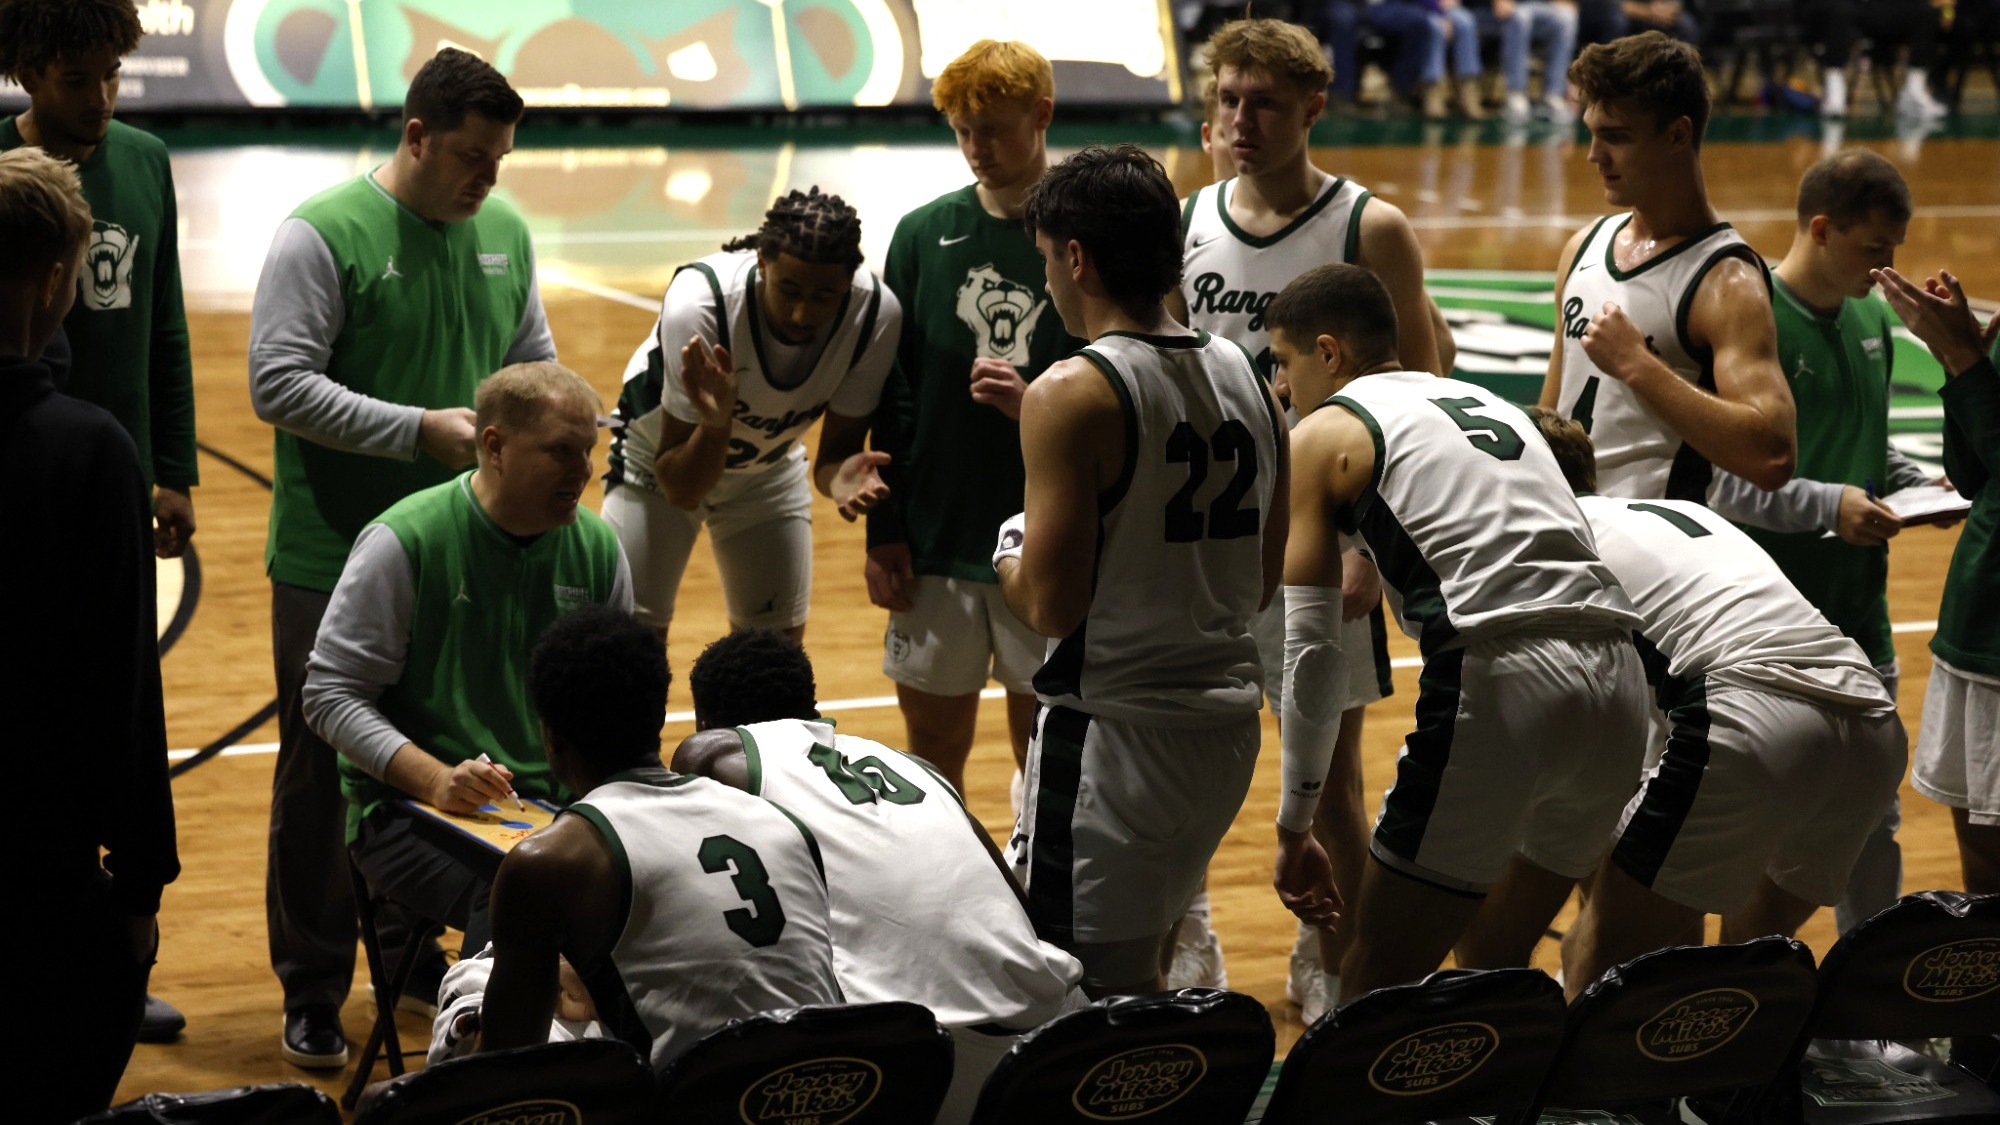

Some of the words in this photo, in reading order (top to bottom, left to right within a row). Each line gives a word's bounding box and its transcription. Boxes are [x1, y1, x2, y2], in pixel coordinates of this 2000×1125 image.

[1192, 272, 1278, 332] Rang
[1427, 396, 1526, 461] 5
[1165, 419, 1260, 542] 22
[1627, 503, 1714, 538] 1
[697, 834, 786, 948] 3
[1924, 947, 2000, 969] Jerse
[1659, 1005, 1749, 1026] Jersey
[1391, 1036, 1487, 1063] Jersey
[1668, 1043, 1700, 1055] SUBS
[761, 1071, 868, 1098] Jersey
[1096, 1059, 1195, 1087] Jersey
[1404, 1076, 1440, 1089] SUBS
[1110, 1101, 1147, 1114] SUBS
